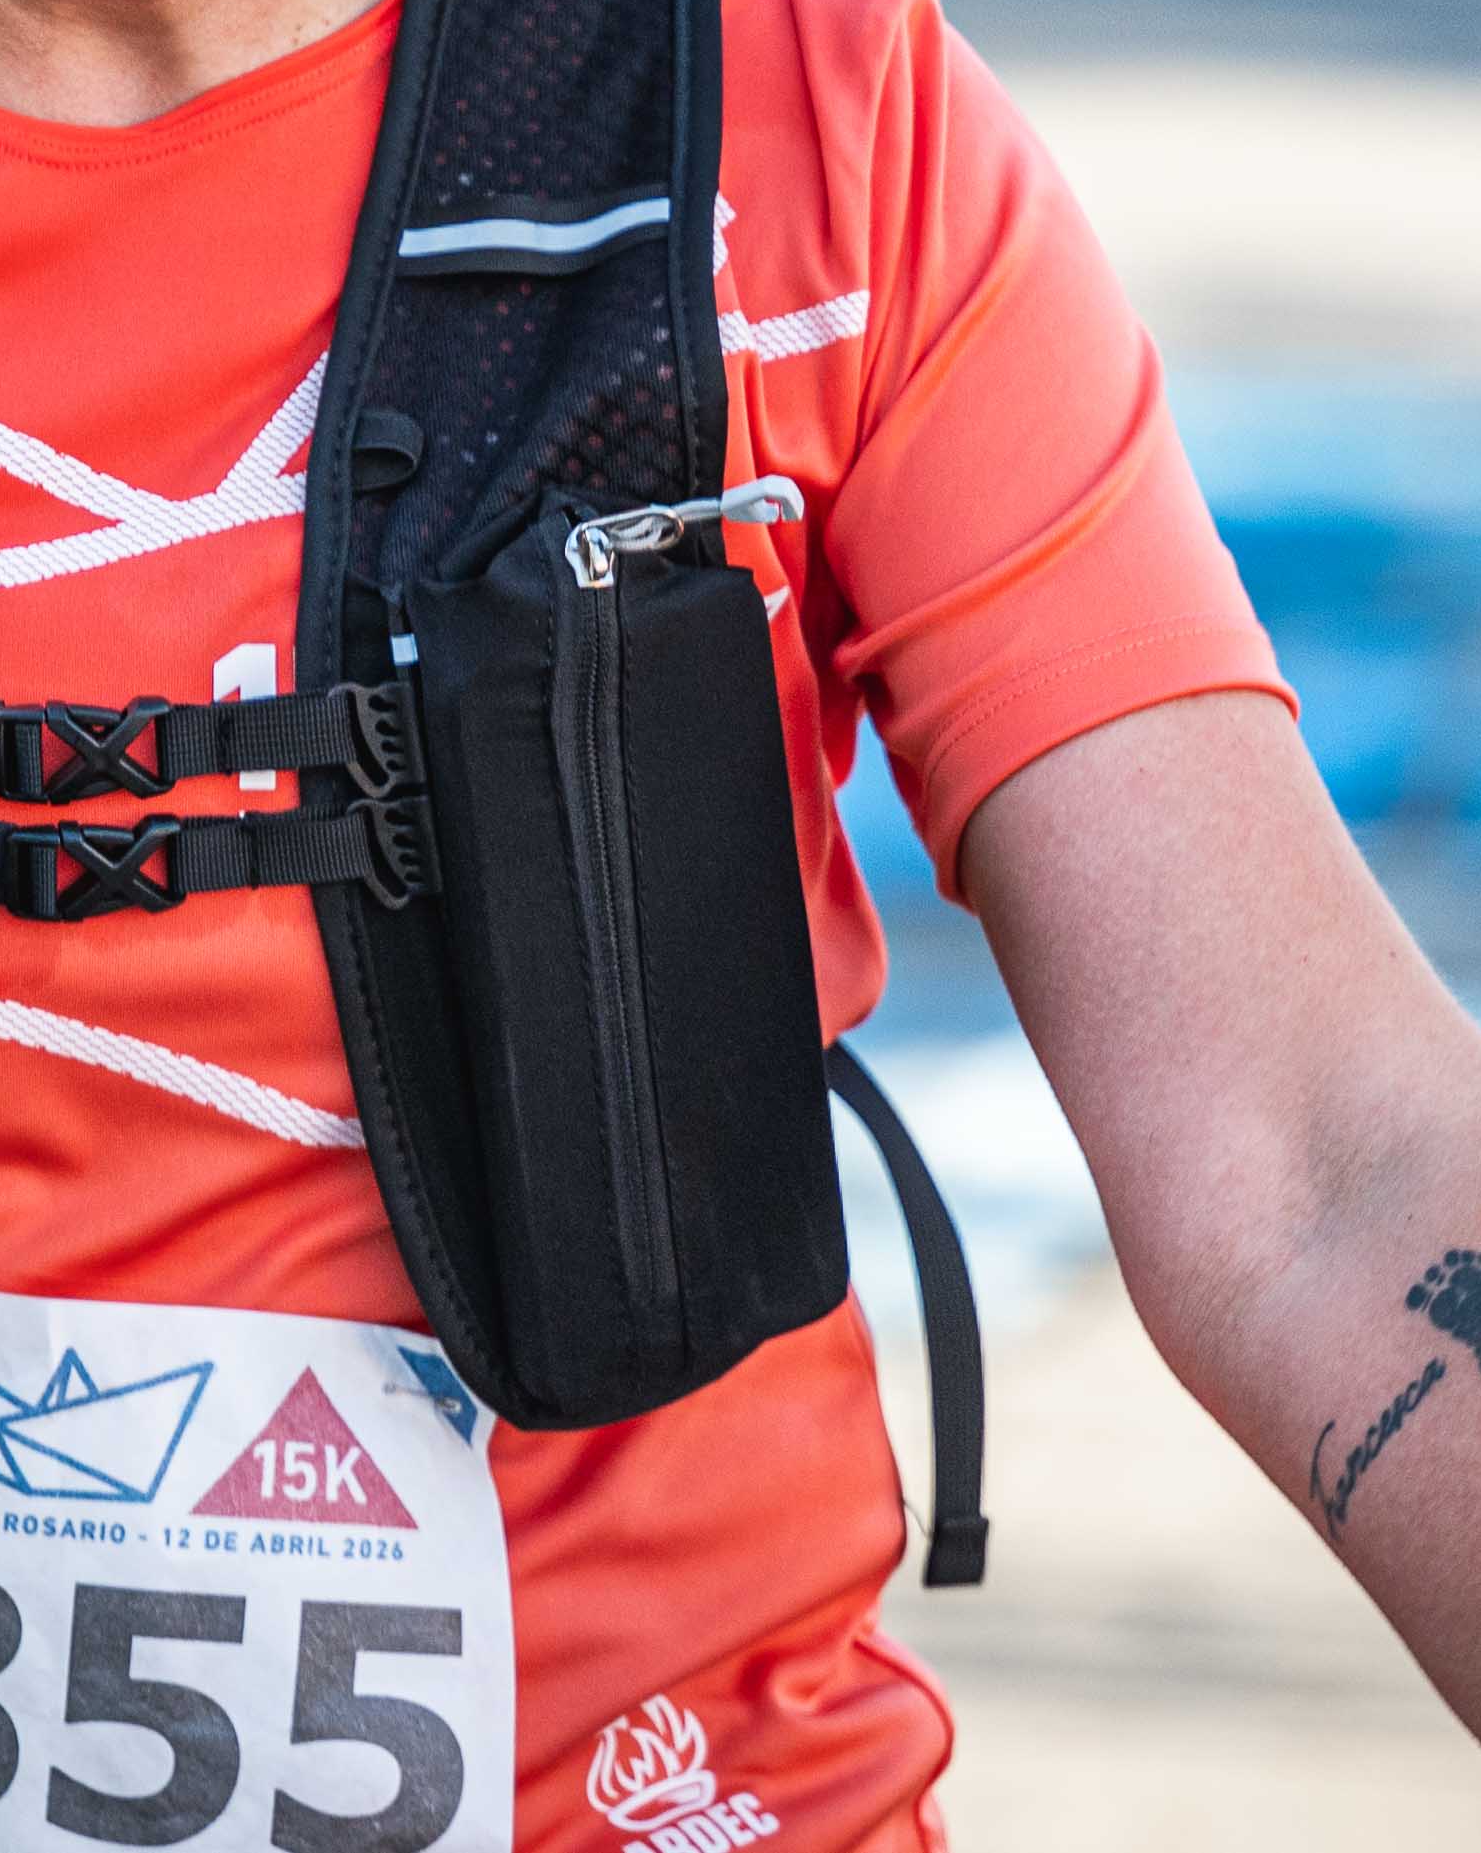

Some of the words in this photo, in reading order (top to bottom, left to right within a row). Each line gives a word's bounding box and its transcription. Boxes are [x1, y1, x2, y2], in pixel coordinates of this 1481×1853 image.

[252, 1438, 368, 1506] 15K
[3, 1512, 127, 1545] ROSARIO
[163, 1527, 191, 1549] 12
[204, 1530, 239, 1552] DE
[249, 1534, 332, 1558] ABRIL
[342, 1538, 406, 1562] 2026
